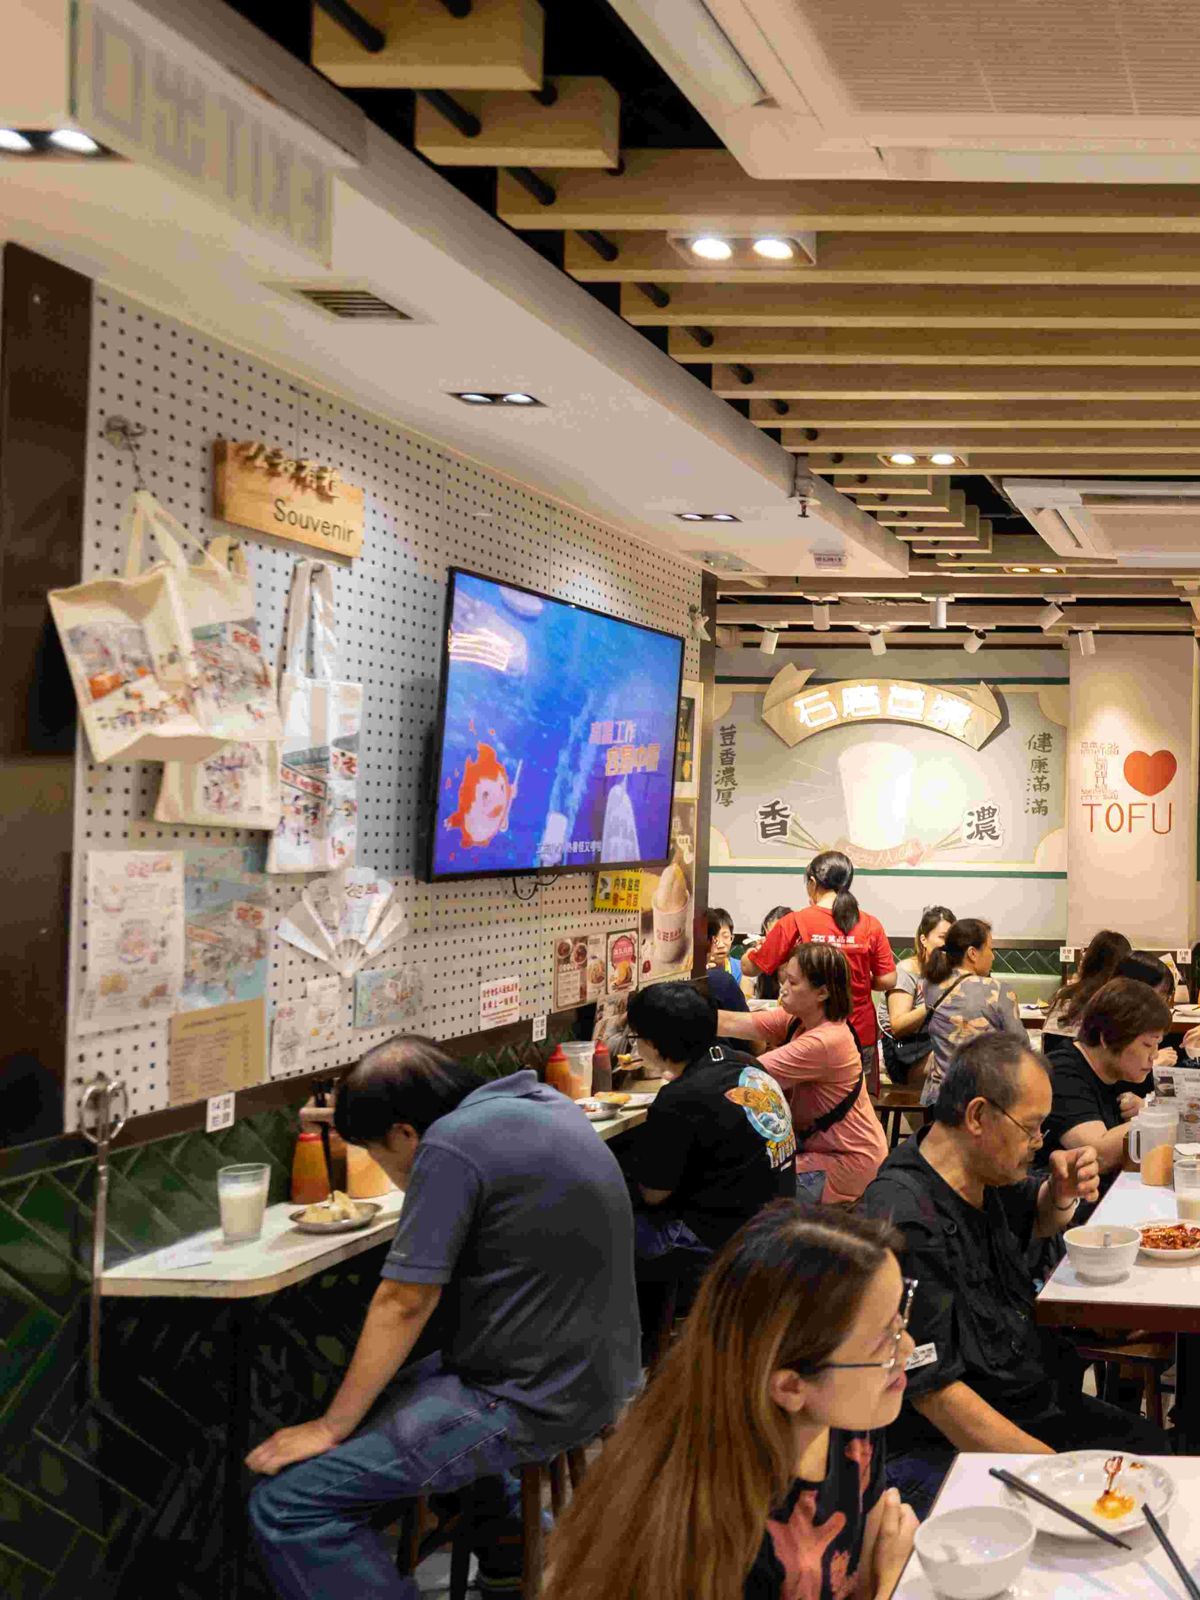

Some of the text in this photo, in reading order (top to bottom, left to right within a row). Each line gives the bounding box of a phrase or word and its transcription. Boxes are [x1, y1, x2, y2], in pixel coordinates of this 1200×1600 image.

[274, 498, 355, 543] Souvenir
[714, 725, 739, 808] 荳香濃厚
[1024, 733, 1054, 816] 健康滿滿
[758, 799, 793, 840] 香
[966, 804, 1003, 842] 濃
[1082, 802, 1172, 835] TOFU
